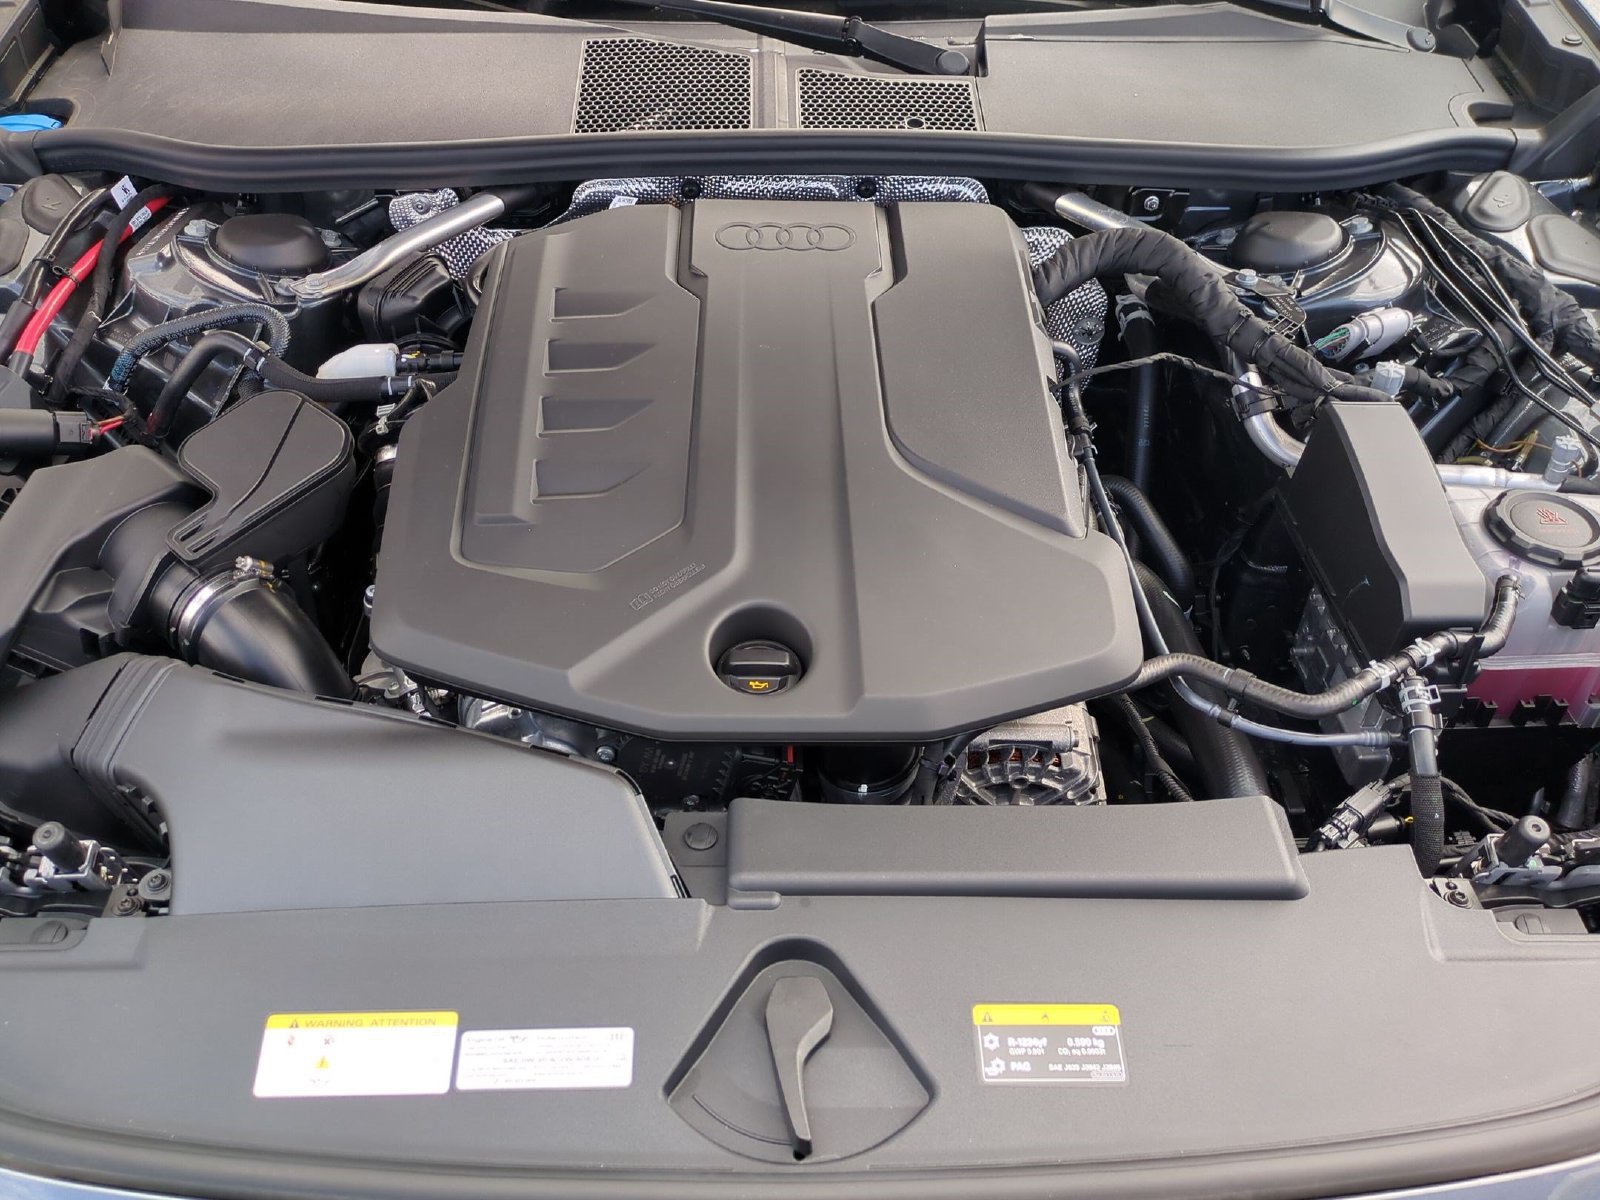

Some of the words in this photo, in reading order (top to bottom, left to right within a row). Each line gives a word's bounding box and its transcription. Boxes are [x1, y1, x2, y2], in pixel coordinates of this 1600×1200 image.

[304, 1018, 364, 1028] WARNING
[369, 1017, 437, 1027] ATTENTION
[1092, 1037, 1105, 1049] kg
[1010, 1061, 1031, 1072] PAG
